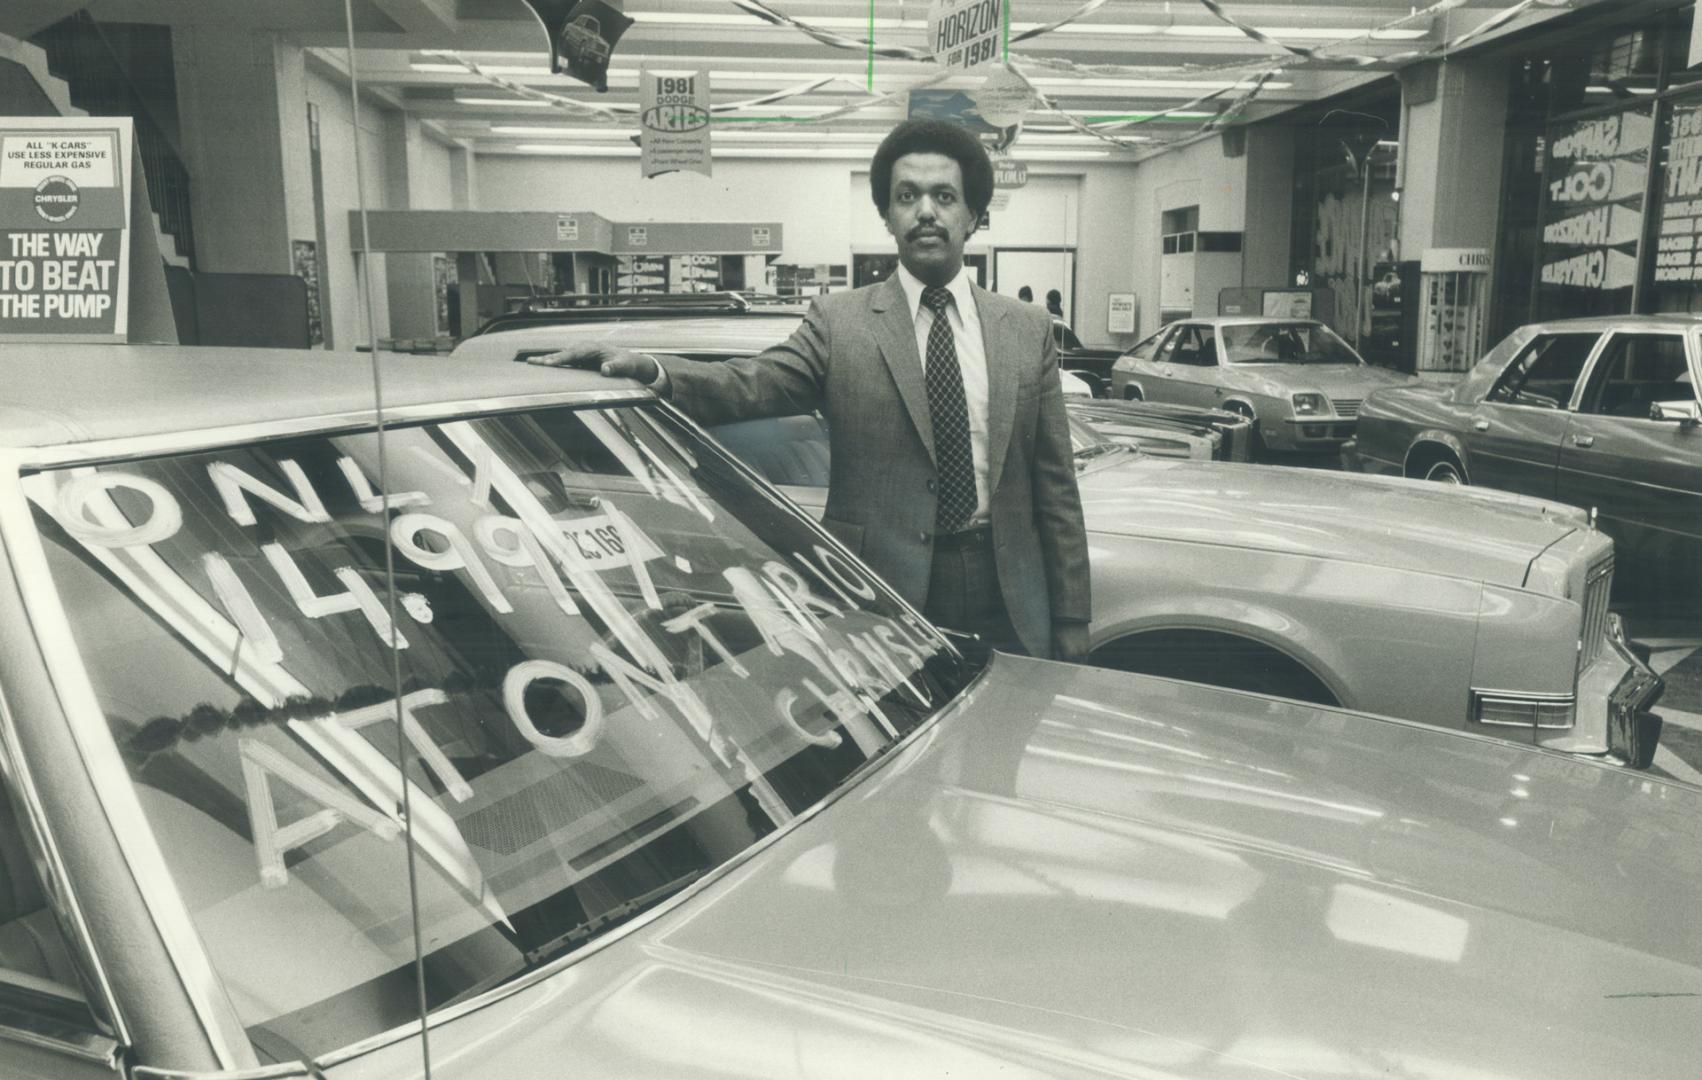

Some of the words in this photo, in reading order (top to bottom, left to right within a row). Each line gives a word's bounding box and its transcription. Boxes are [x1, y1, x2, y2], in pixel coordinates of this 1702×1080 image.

[936, 0, 1000, 53] HORIZON
[964, 35, 997, 69] 1981
[656, 77, 695, 95] 1981
[656, 95, 695, 104] DODGE
[645, 105, 707, 131] ARIES
[7, 150, 26, 160] USE
[29, 150, 52, 160] LESS
[54, 150, 106, 160] EXPENSIVE
[26, 141, 43, 150] ALL
[23, 160, 67, 169] REGULAR
[71, 160, 91, 169] GAS
[35, 195, 78, 203] CHRYSLER
[8, 233, 50, 257] THE
[53, 233, 104, 257] WAY
[0, 260, 35, 291] TO
[43, 260, 115, 291] BEAT
[0, 294, 41, 318] THE
[44, 294, 111, 318] PUMP
[56, 442, 503, 549] ONLY
[238, 688, 476, 889] AT
